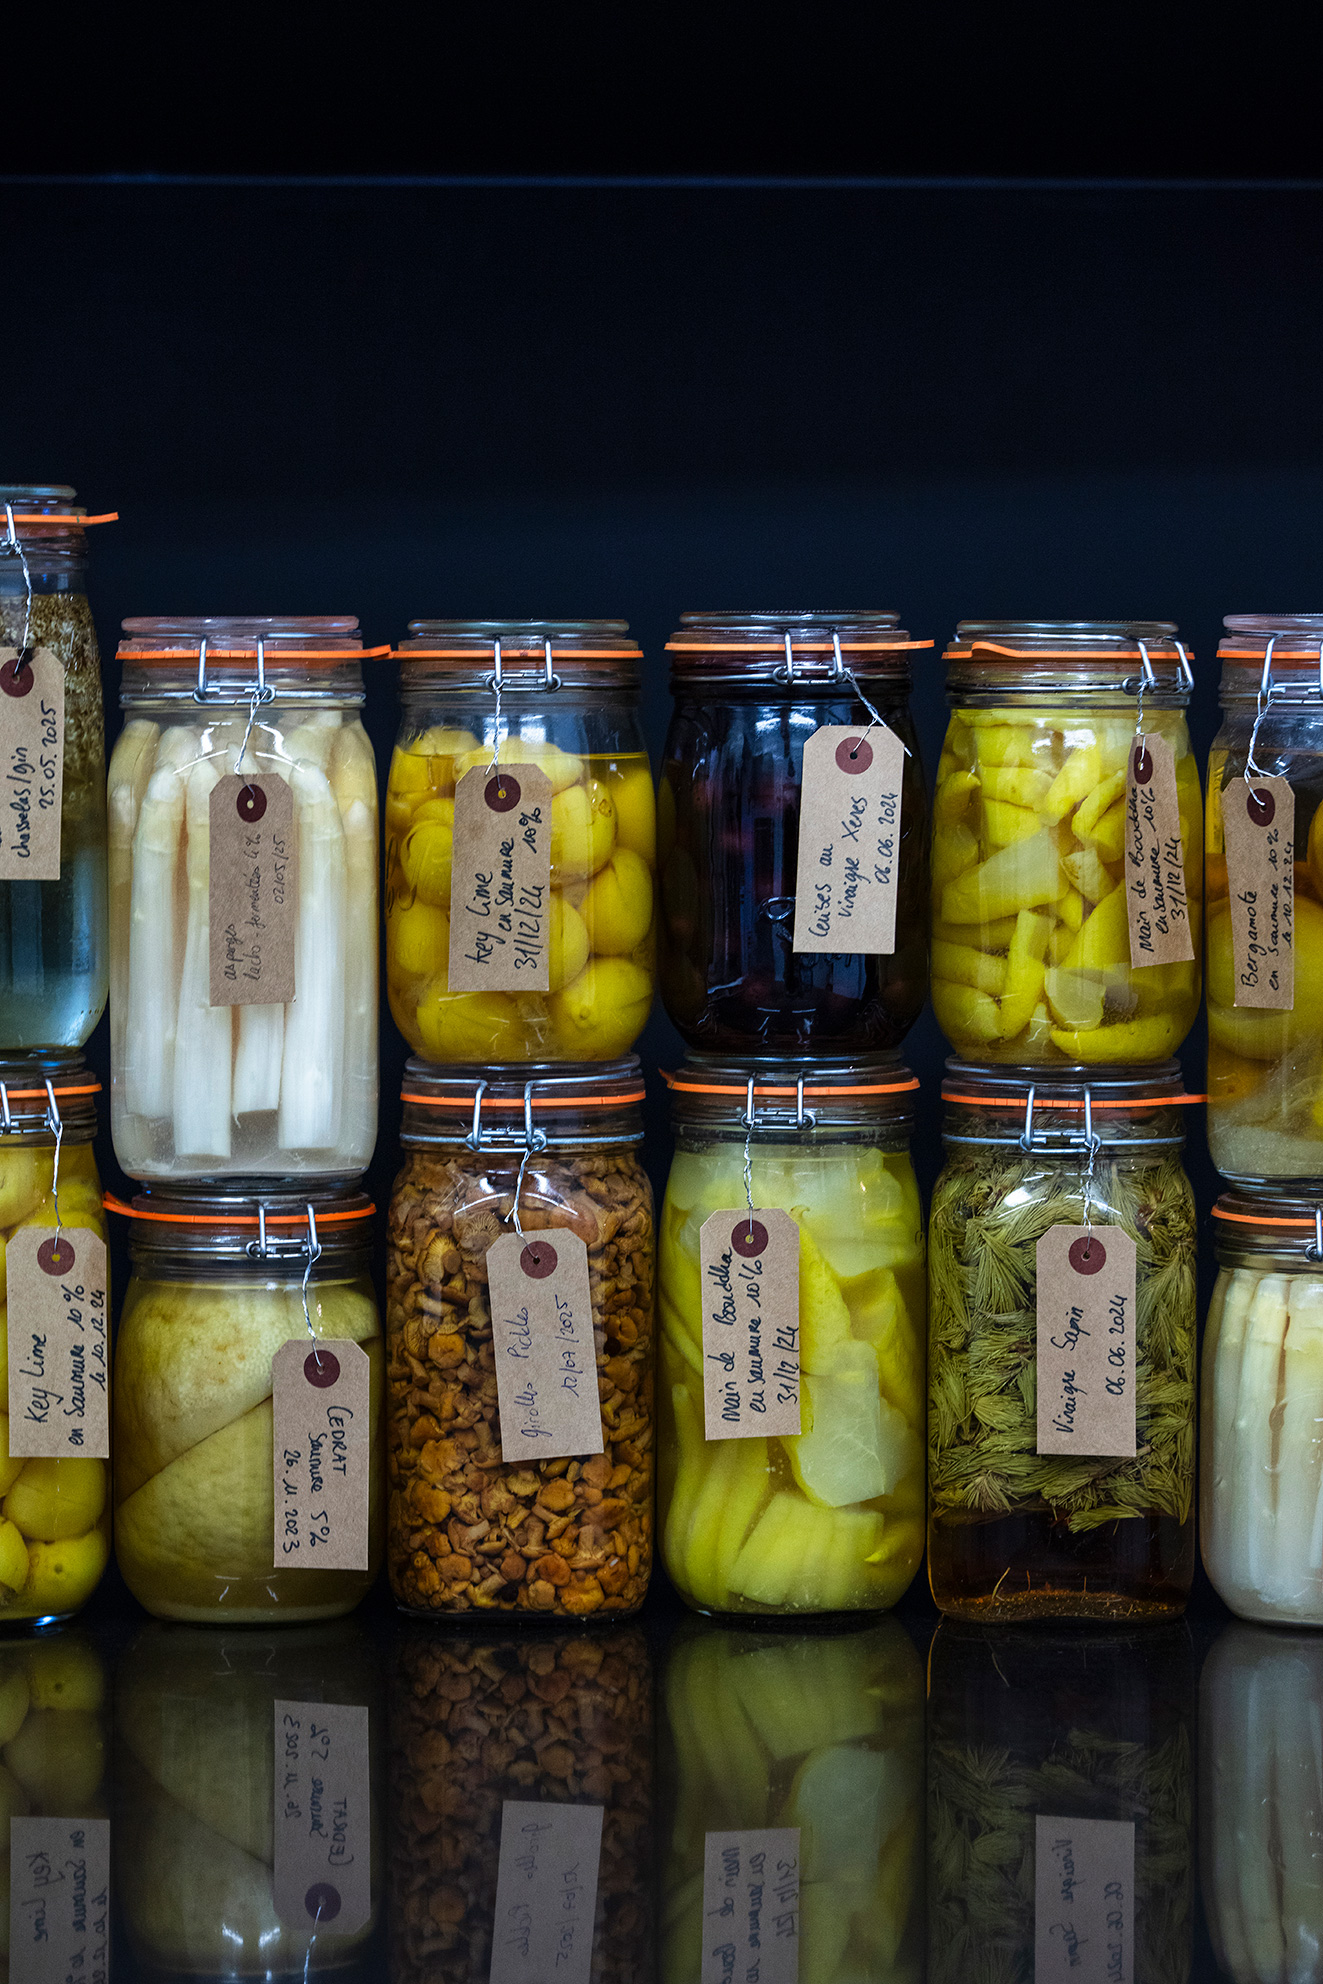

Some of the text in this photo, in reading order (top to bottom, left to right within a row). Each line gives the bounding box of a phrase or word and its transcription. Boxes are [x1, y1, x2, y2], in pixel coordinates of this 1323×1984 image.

[818, 844, 833, 866] au
[1131, 878, 1146, 898] de
[1237, 890, 1267, 987] Bergamote
[1269, 970, 1279, 990] en
[1050, 1306, 1090, 1351] Sapin
[707, 1352, 735, 1371] de
[19, 1334, 63, 1423] Key Lime
[68, 1428, 84, 1445] en
[327, 1406, 354, 1476] CEDRAT
